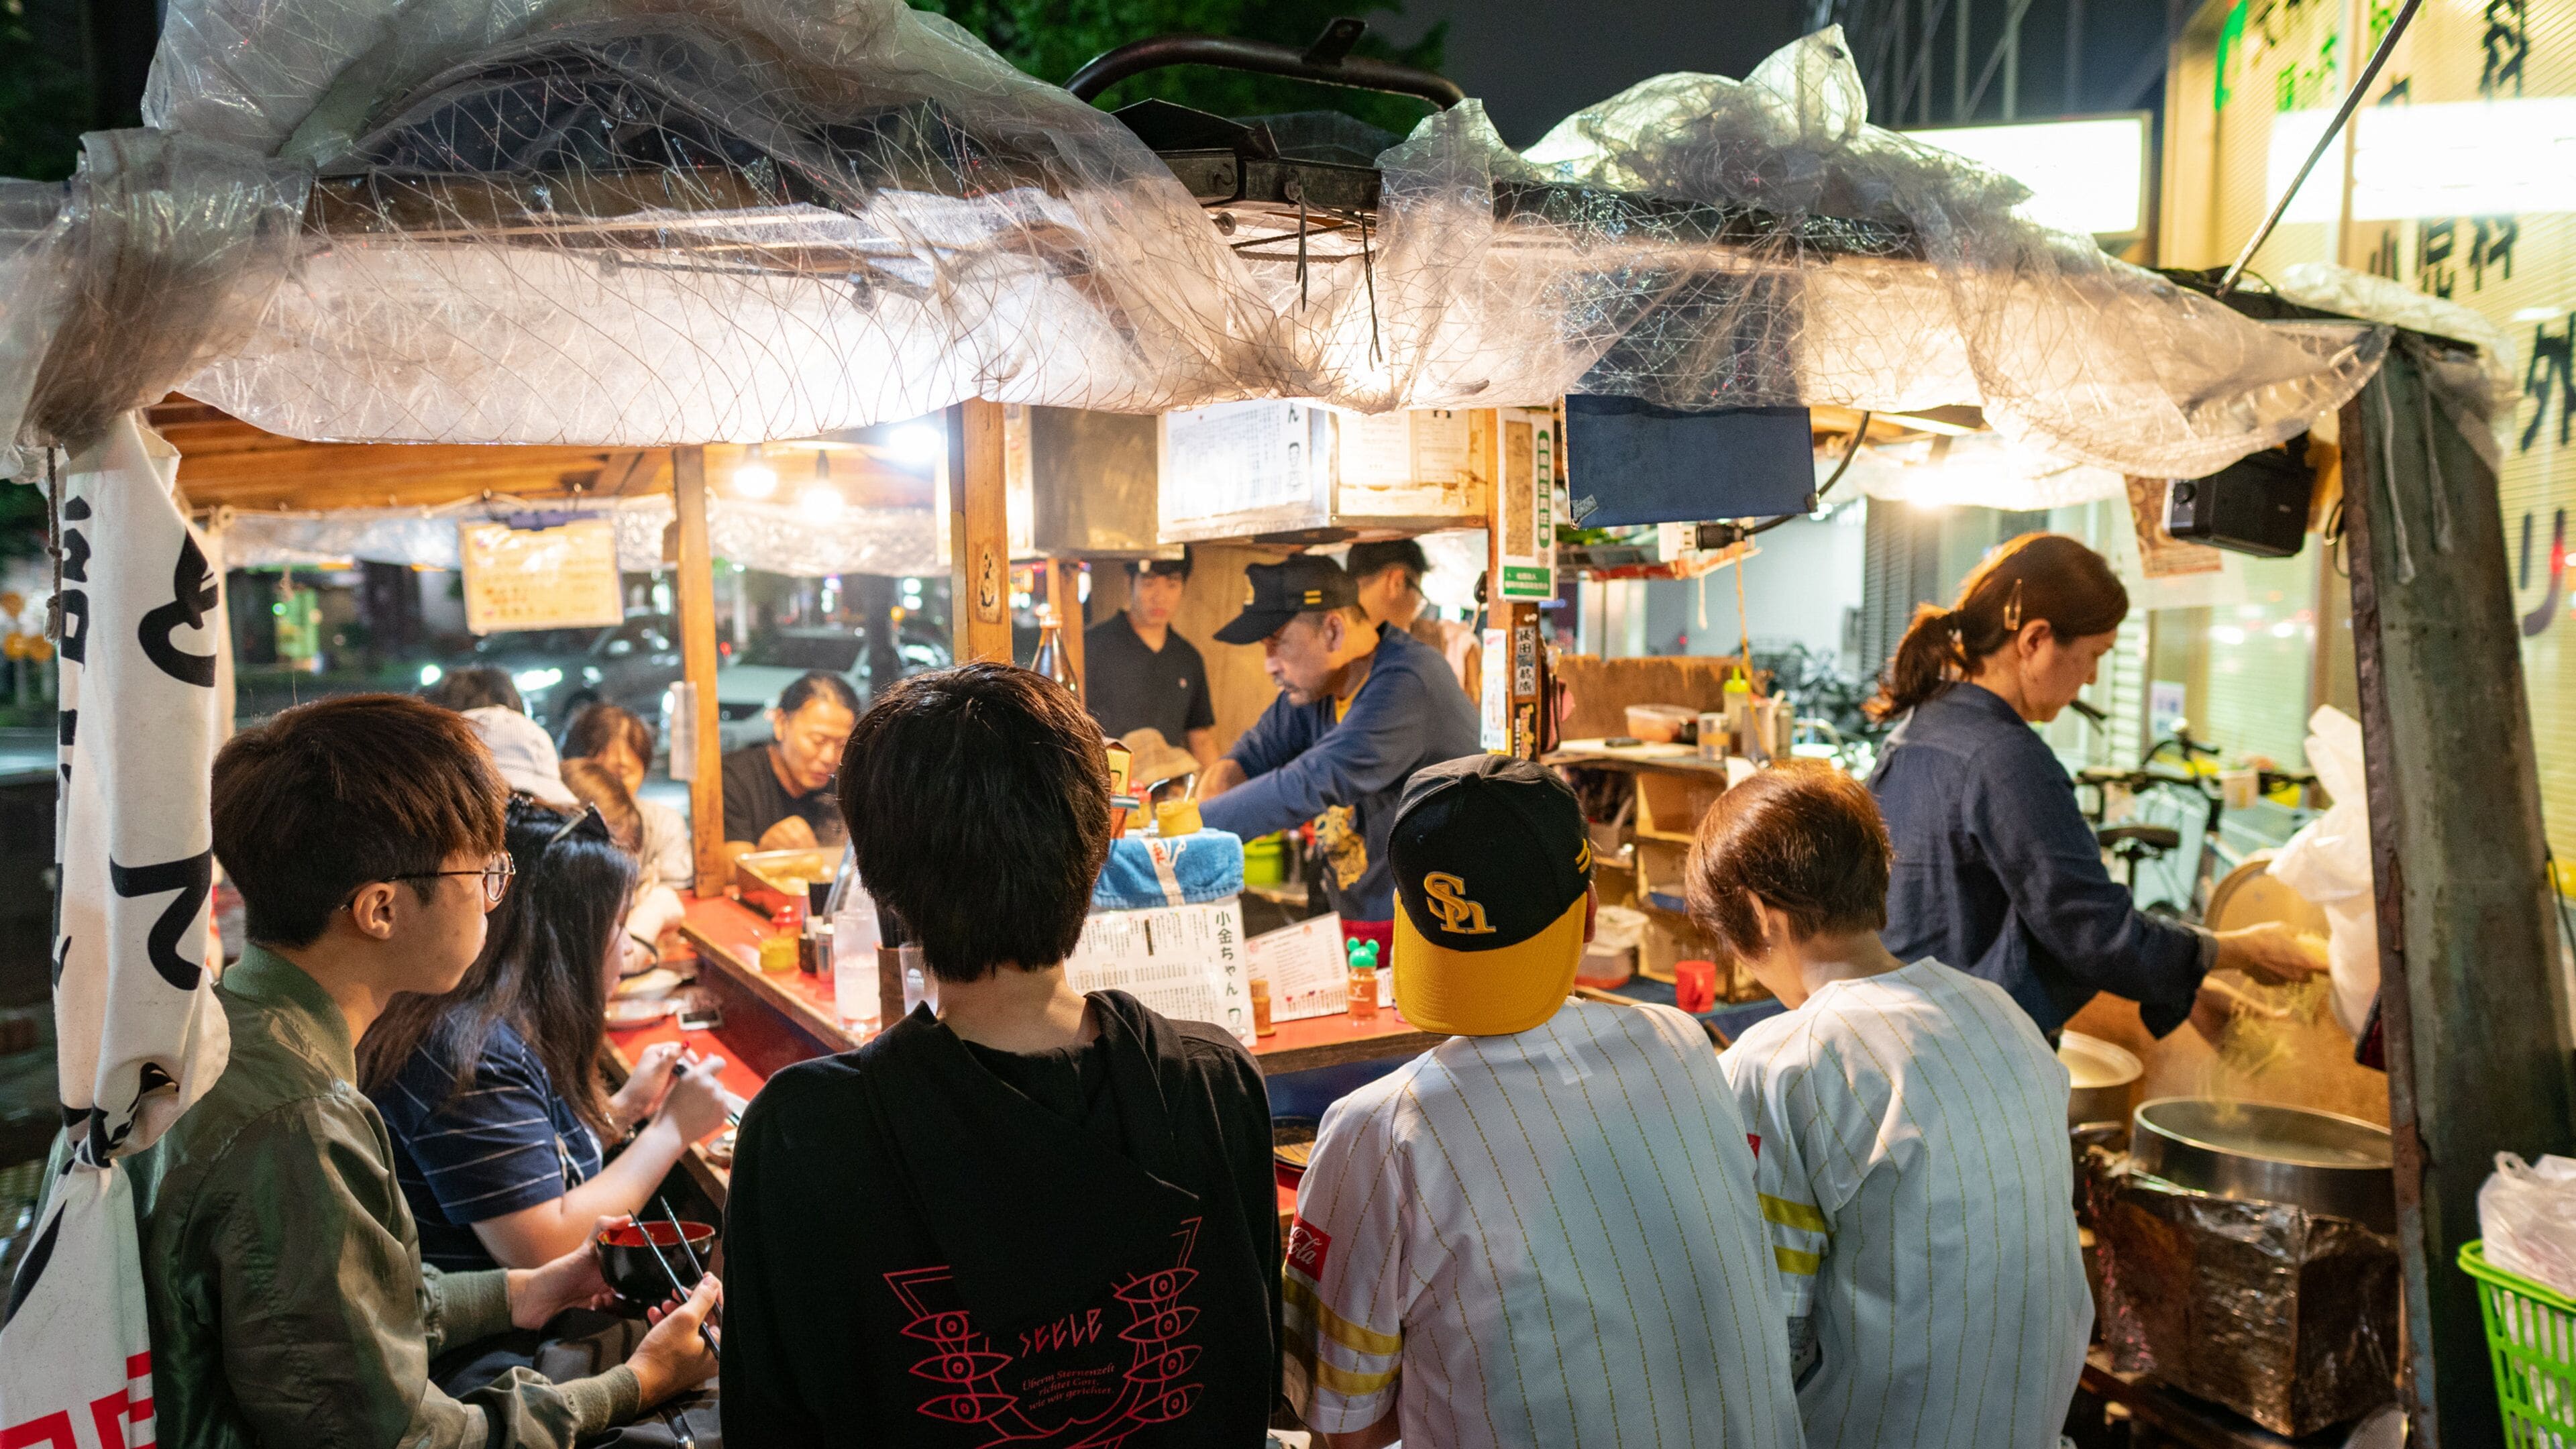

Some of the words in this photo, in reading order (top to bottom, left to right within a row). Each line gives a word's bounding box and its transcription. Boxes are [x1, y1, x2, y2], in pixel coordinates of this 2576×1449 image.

[1215, 910, 1238, 998] 小金ちゃん
[1019, 1307, 1103, 1358] SEELE
[1056, 1362, 1116, 1379] Sternenzelt
[1038, 1380, 1071, 1396] richtet
[1028, 1399, 1046, 1411] wie
[1046, 1391, 1065, 1403] wir
